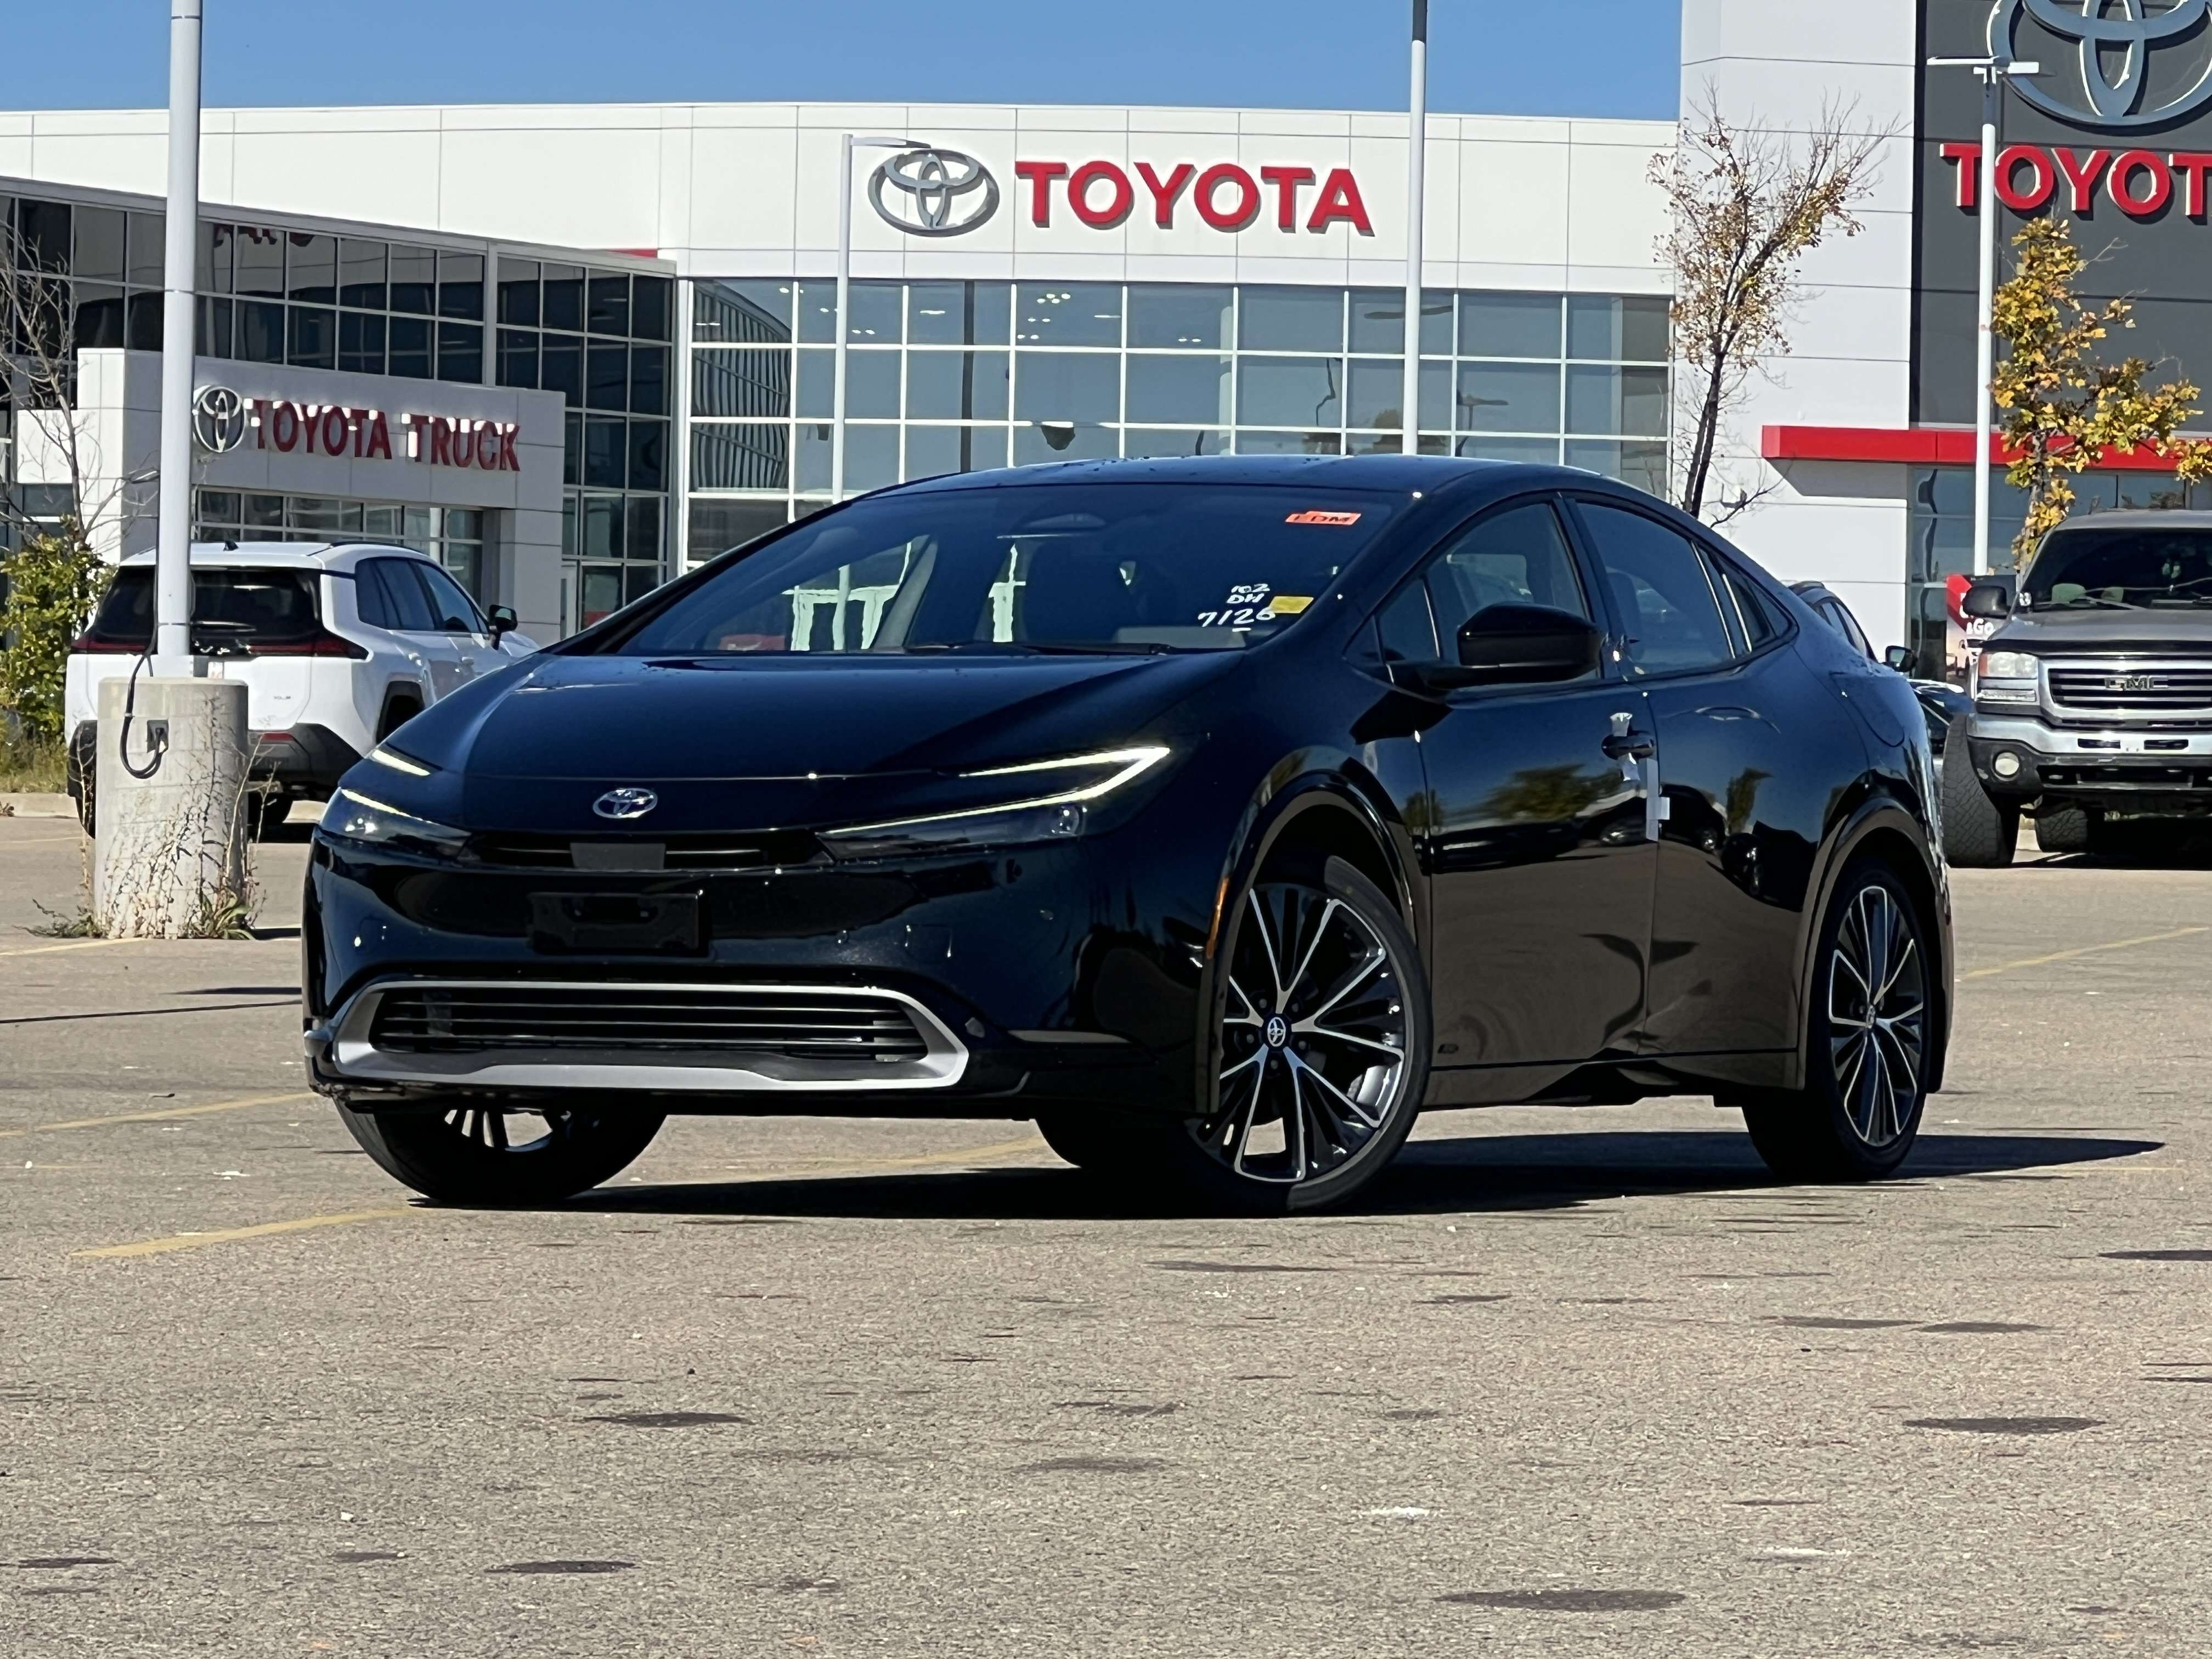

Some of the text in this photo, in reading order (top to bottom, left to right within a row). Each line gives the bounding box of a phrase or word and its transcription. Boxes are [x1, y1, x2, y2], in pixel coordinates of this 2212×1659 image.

[1015, 160, 1375, 237] TOYOTA
[1940, 143, 2211, 216] TOYOT
[245, 398, 521, 471] TOYOTA TRUCK
[2104, 675, 2168, 691] GMC
